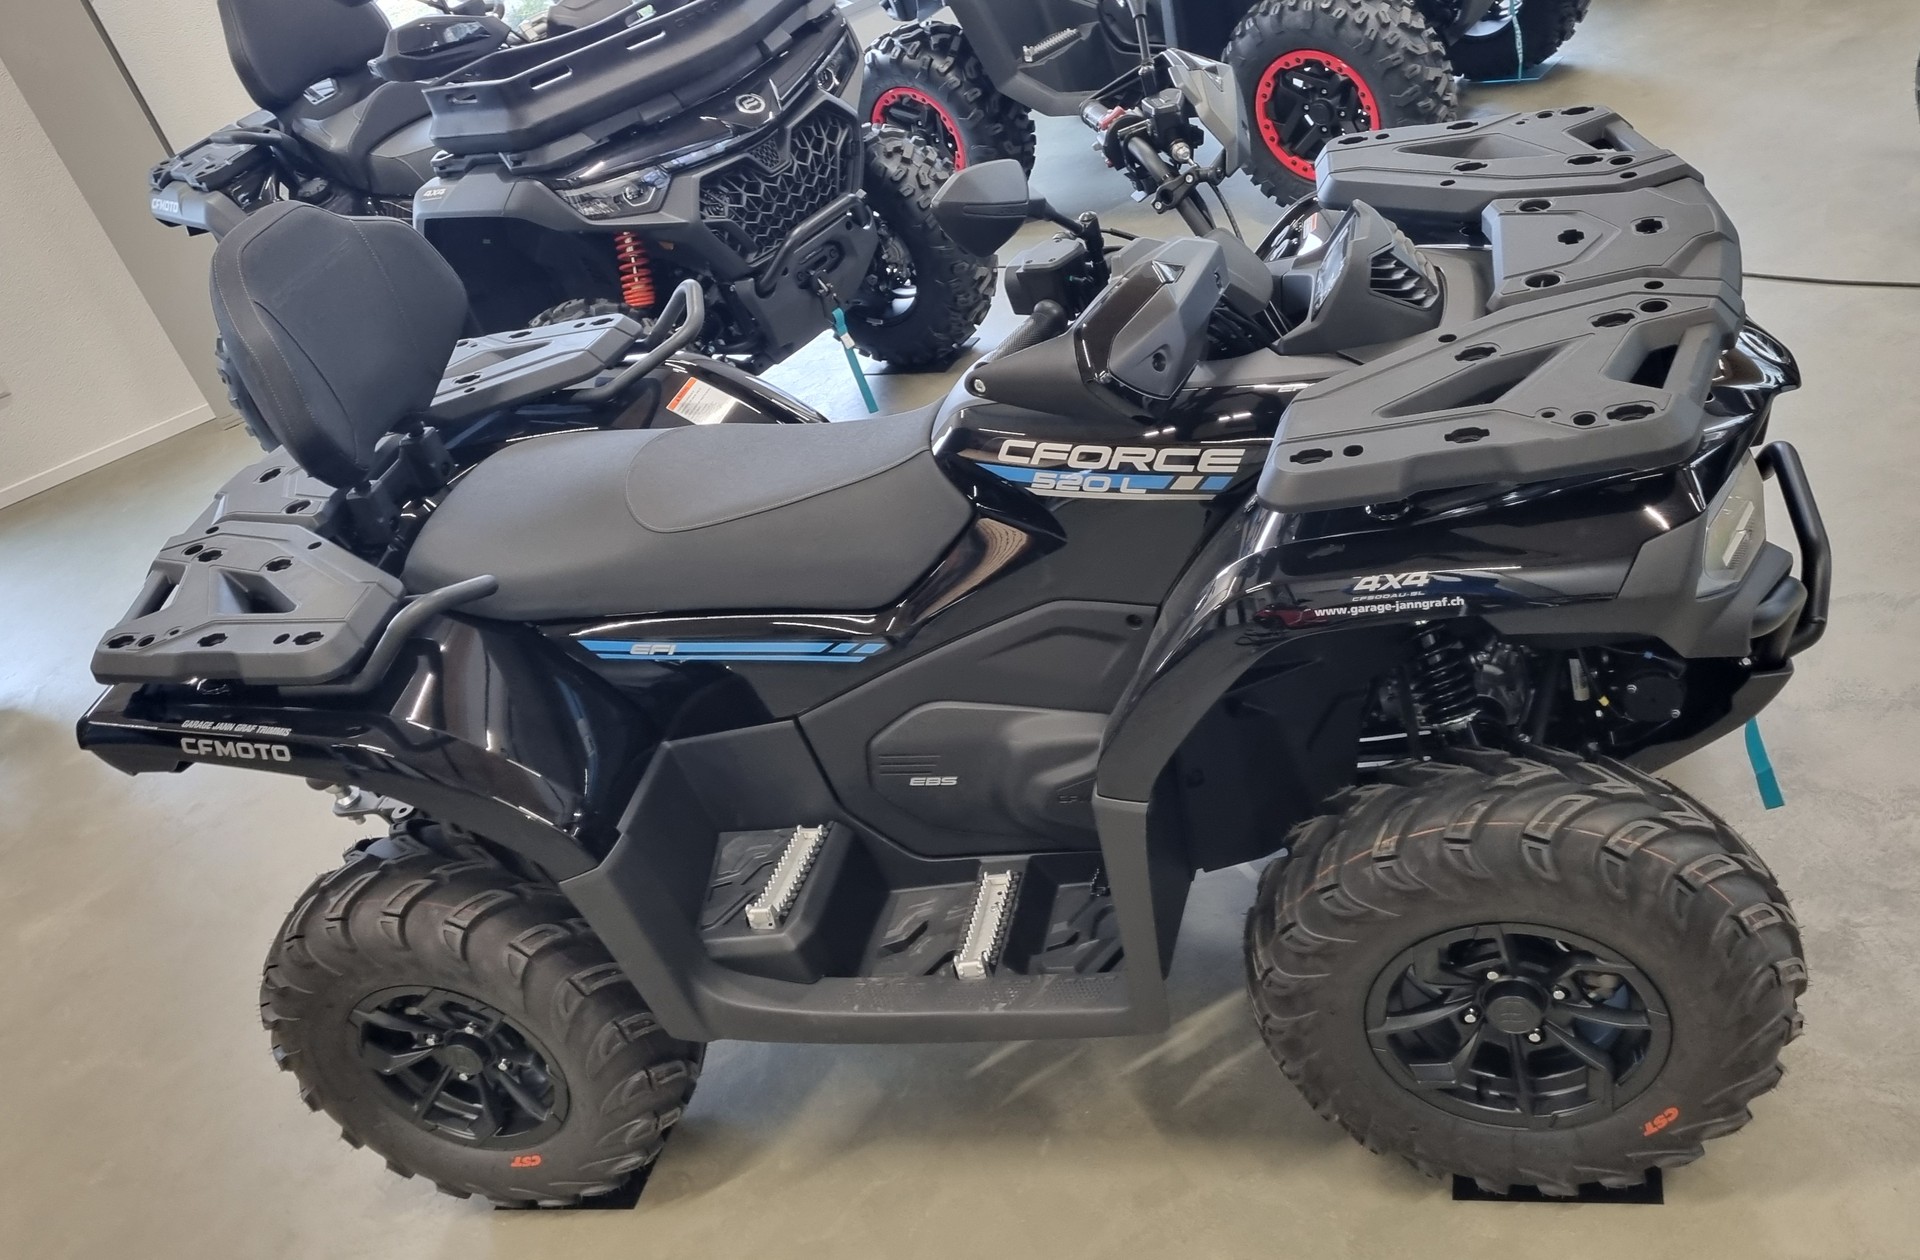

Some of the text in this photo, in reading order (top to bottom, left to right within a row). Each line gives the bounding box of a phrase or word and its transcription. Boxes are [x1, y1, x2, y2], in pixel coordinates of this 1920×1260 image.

[151, 198, 179, 213] CFMOTO
[998, 439, 1246, 473] CFORCE
[1031, 472, 1147, 494] 520 L
[1314, 596, 1465, 617] www.garage-janngraf.ch
[630, 644, 676, 655] EFI
[181, 720, 214, 730] GARAGE
[234, 724, 257, 733] GRAF
[180, 737, 292, 762] CFMOTO
[909, 776, 958, 786] EBS
[1643, 1107, 1679, 1137] CST
[510, 1155, 542, 1167] CST
